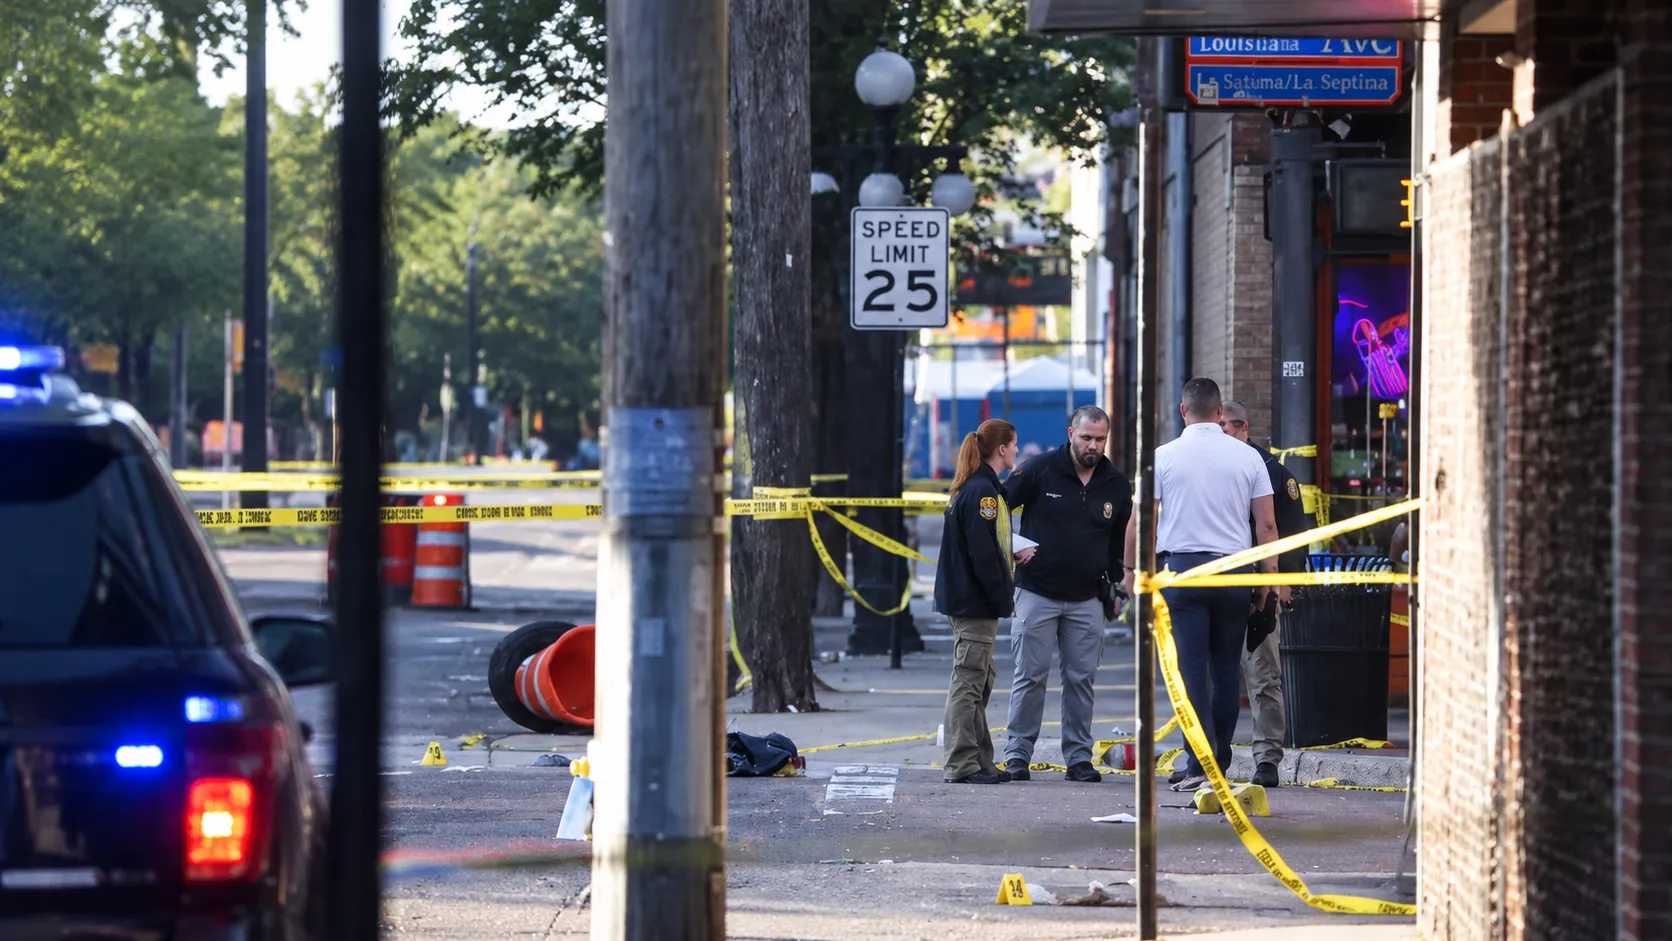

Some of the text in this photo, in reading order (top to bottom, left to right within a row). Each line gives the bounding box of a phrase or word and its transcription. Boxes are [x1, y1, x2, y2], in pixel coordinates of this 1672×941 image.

[862, 221, 940, 238] SPEED
[871, 245, 930, 263] LIMIT
[862, 269, 938, 312] 25
